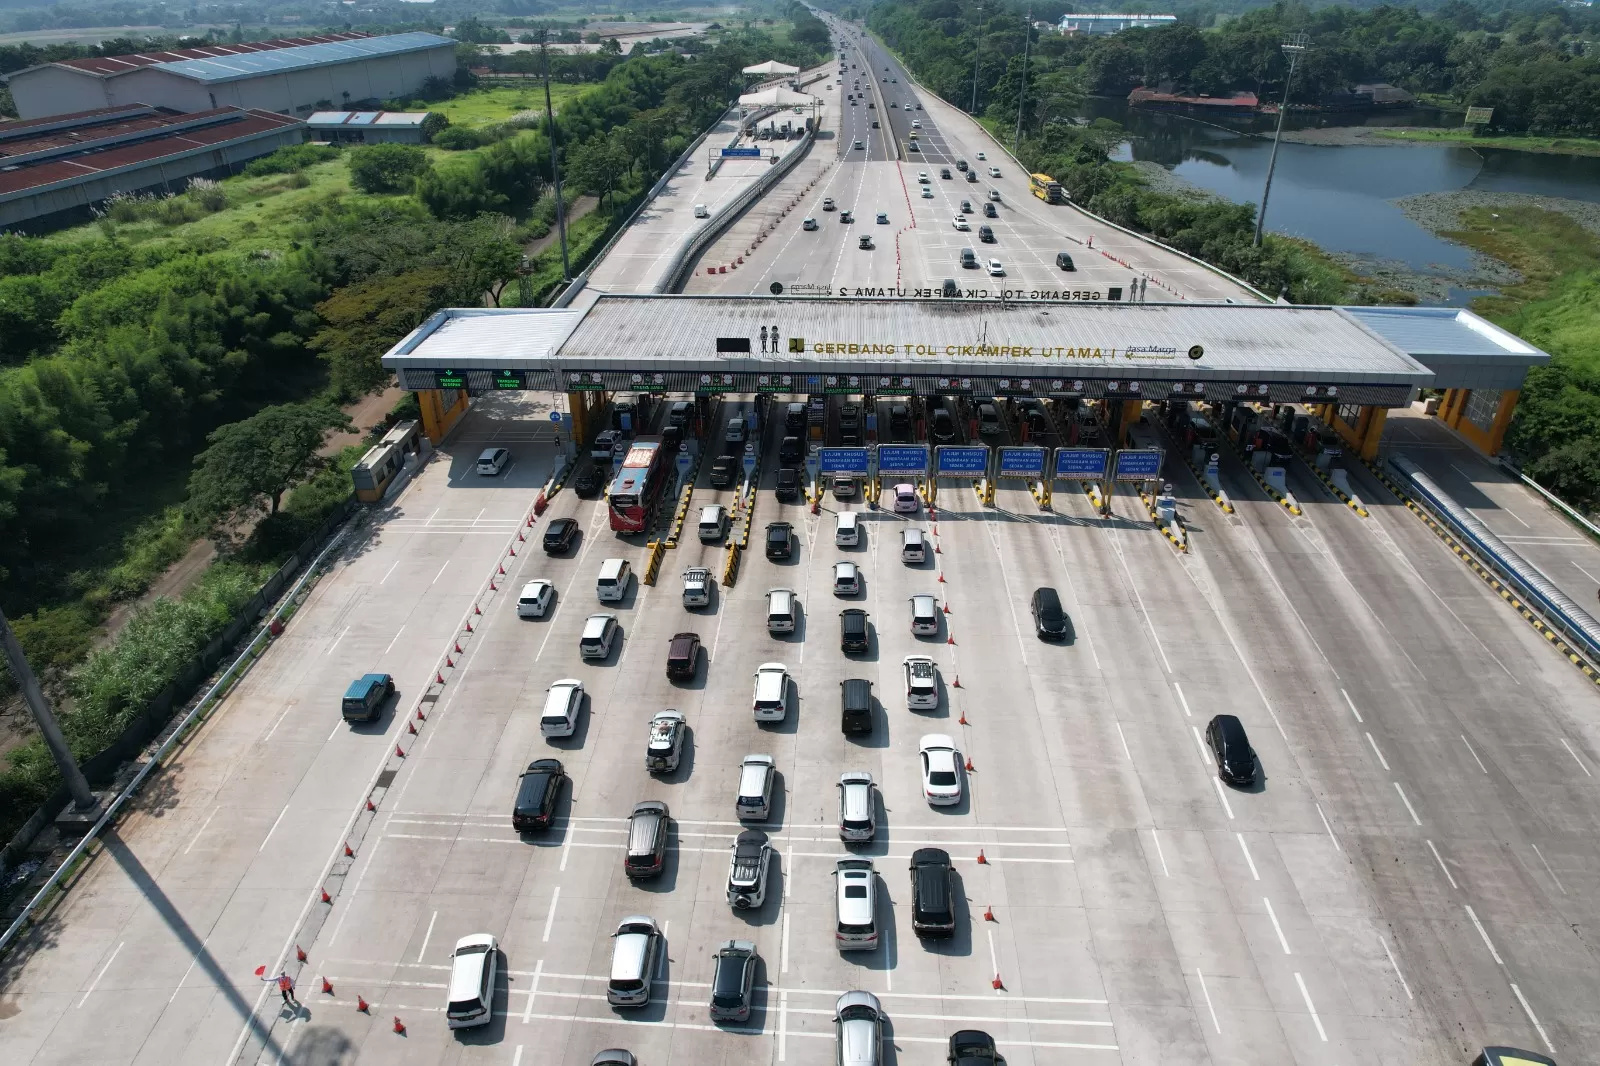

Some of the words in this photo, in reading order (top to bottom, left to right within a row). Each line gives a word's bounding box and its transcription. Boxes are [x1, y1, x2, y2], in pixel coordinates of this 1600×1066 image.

[814, 343, 895, 355] GERBANG
[904, 344, 937, 356] TOL
[946, 345, 1033, 358] CIKAMPEK
[1043, 347, 1103, 359] UTAMA
[1127, 345, 1147, 353] Jasa
[1149, 346, 1177, 355] Marga
